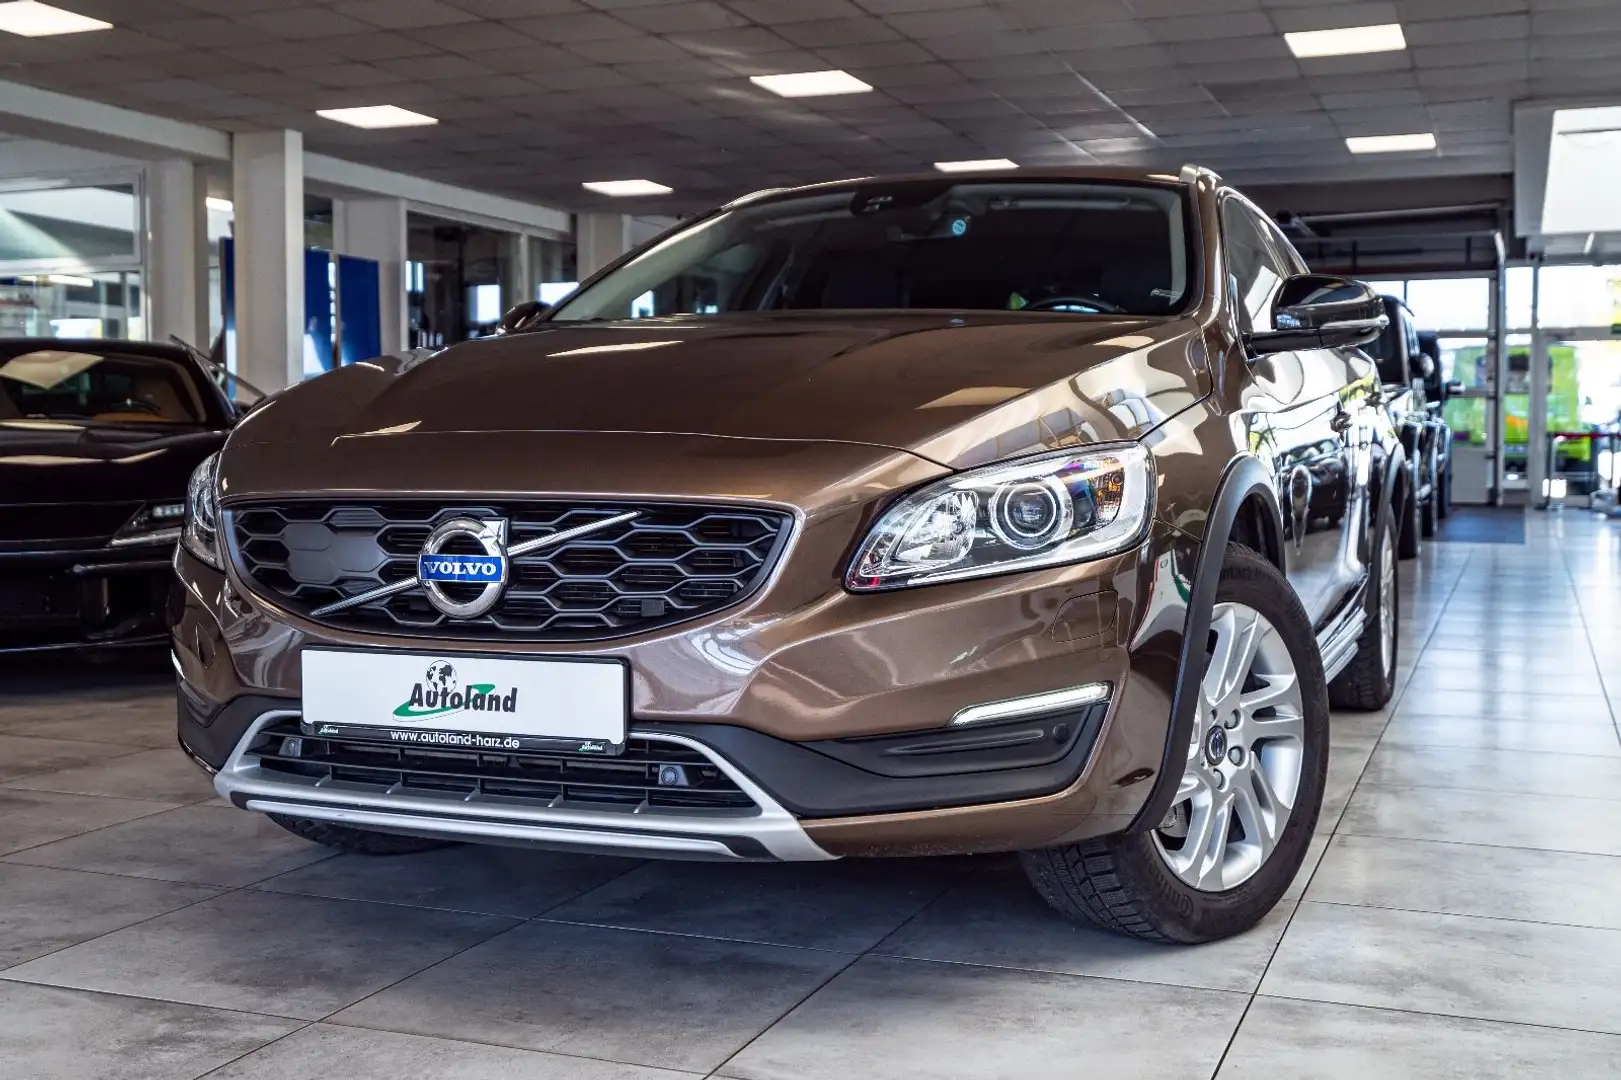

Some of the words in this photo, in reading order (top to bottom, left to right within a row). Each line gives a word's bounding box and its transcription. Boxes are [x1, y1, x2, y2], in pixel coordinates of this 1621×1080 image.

[424, 561, 497, 576] VOLVO
[408, 682, 518, 712] Autoland
[390, 731, 520, 748] www.autoland-harz.de
